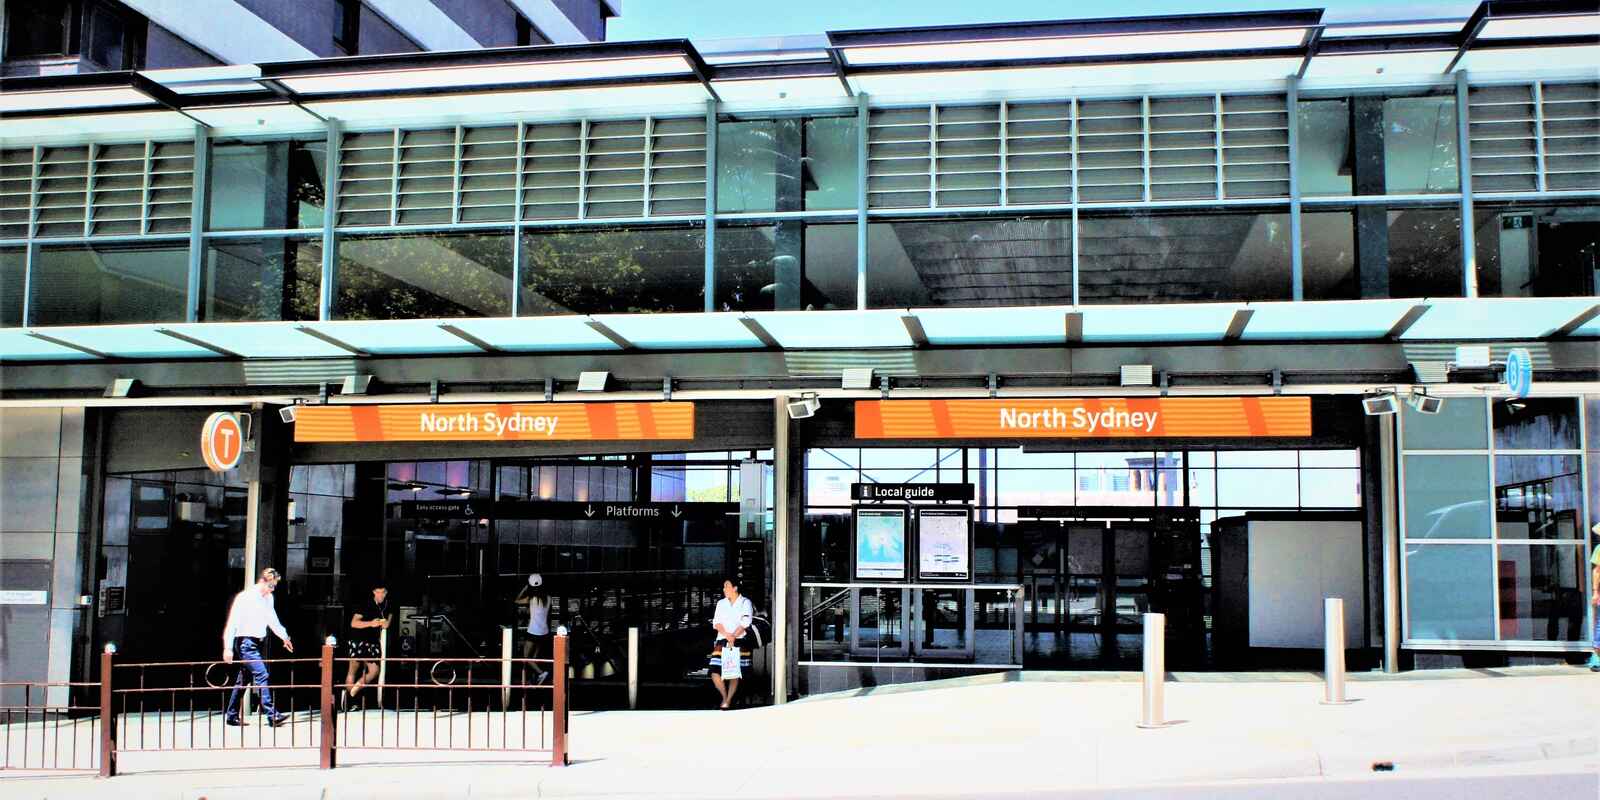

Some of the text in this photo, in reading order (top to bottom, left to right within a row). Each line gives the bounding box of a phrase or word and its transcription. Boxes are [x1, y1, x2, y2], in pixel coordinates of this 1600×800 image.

[420, 412, 559, 436] North Sydney
[999, 407, 1158, 433] North Sydney
[221, 428, 234, 459] T
[875, 486, 903, 497] Local
[904, 486, 935, 499] guide
[429, 504, 447, 512] access
[448, 504, 460, 512] gate
[606, 505, 660, 517] Platforms
